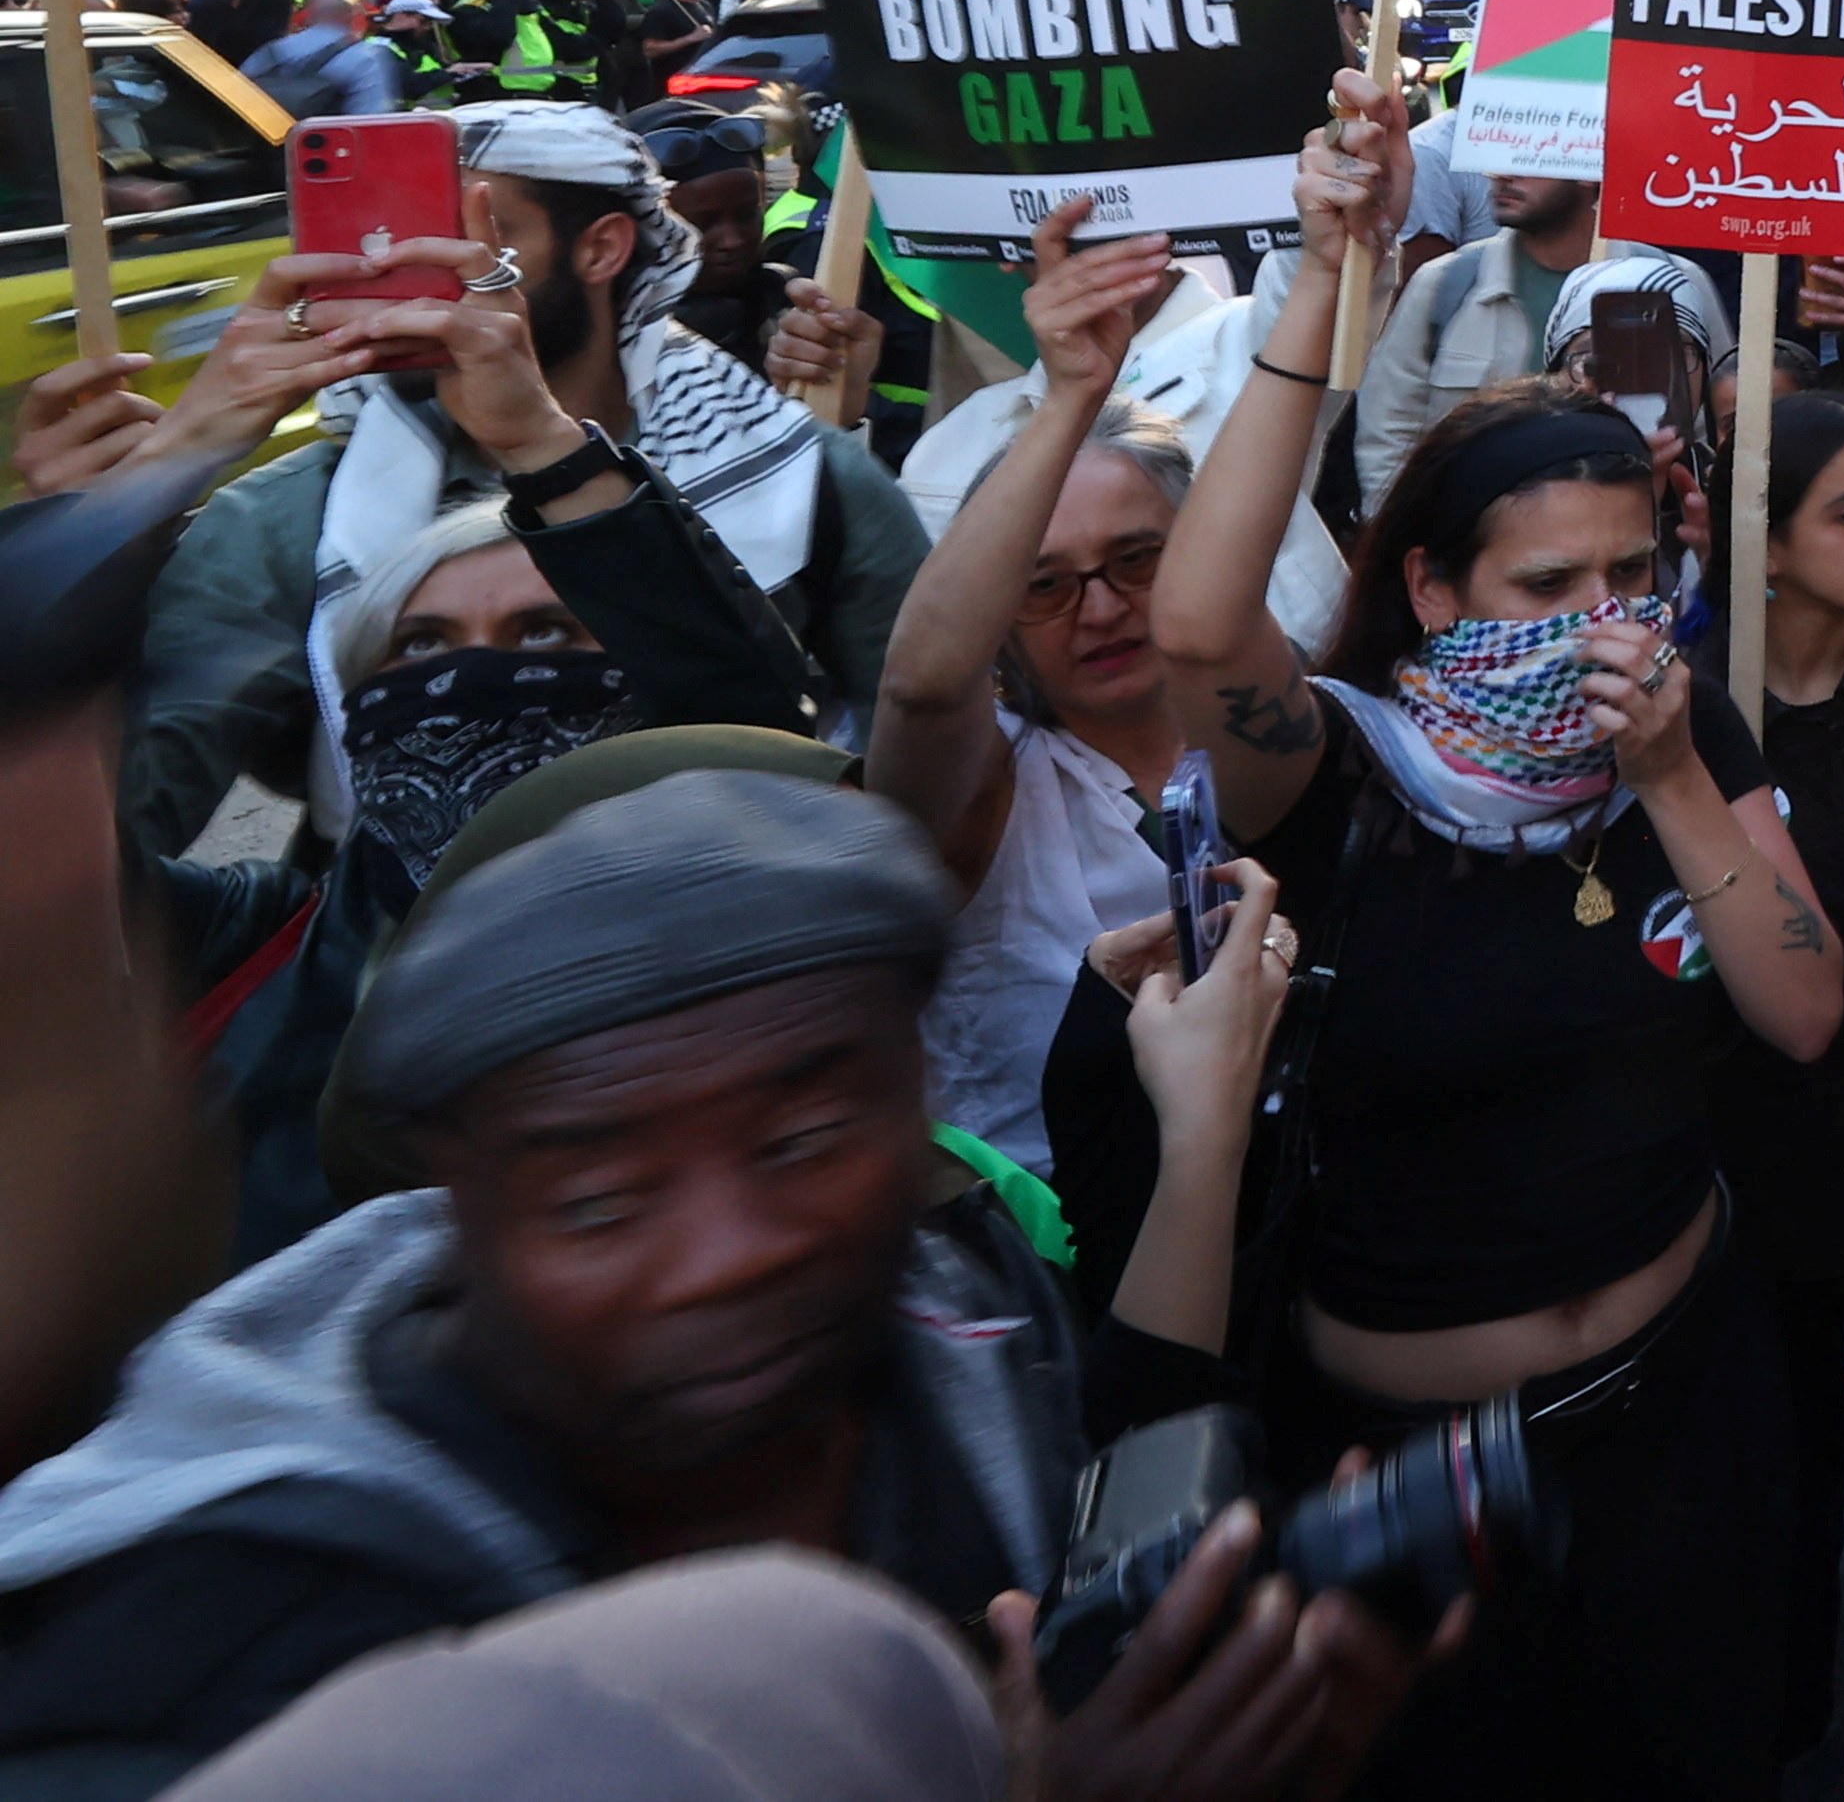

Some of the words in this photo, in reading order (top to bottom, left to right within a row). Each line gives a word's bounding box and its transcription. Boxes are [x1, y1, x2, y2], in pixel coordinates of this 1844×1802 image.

[958, 64, 1156, 146] GAZA
[1471, 102, 1562, 127] Palestine
[1009, 186, 1052, 226] FOA
[1084, 206, 1134, 224] L-AQSA
[1719, 213, 1812, 240] swp.org.uk
